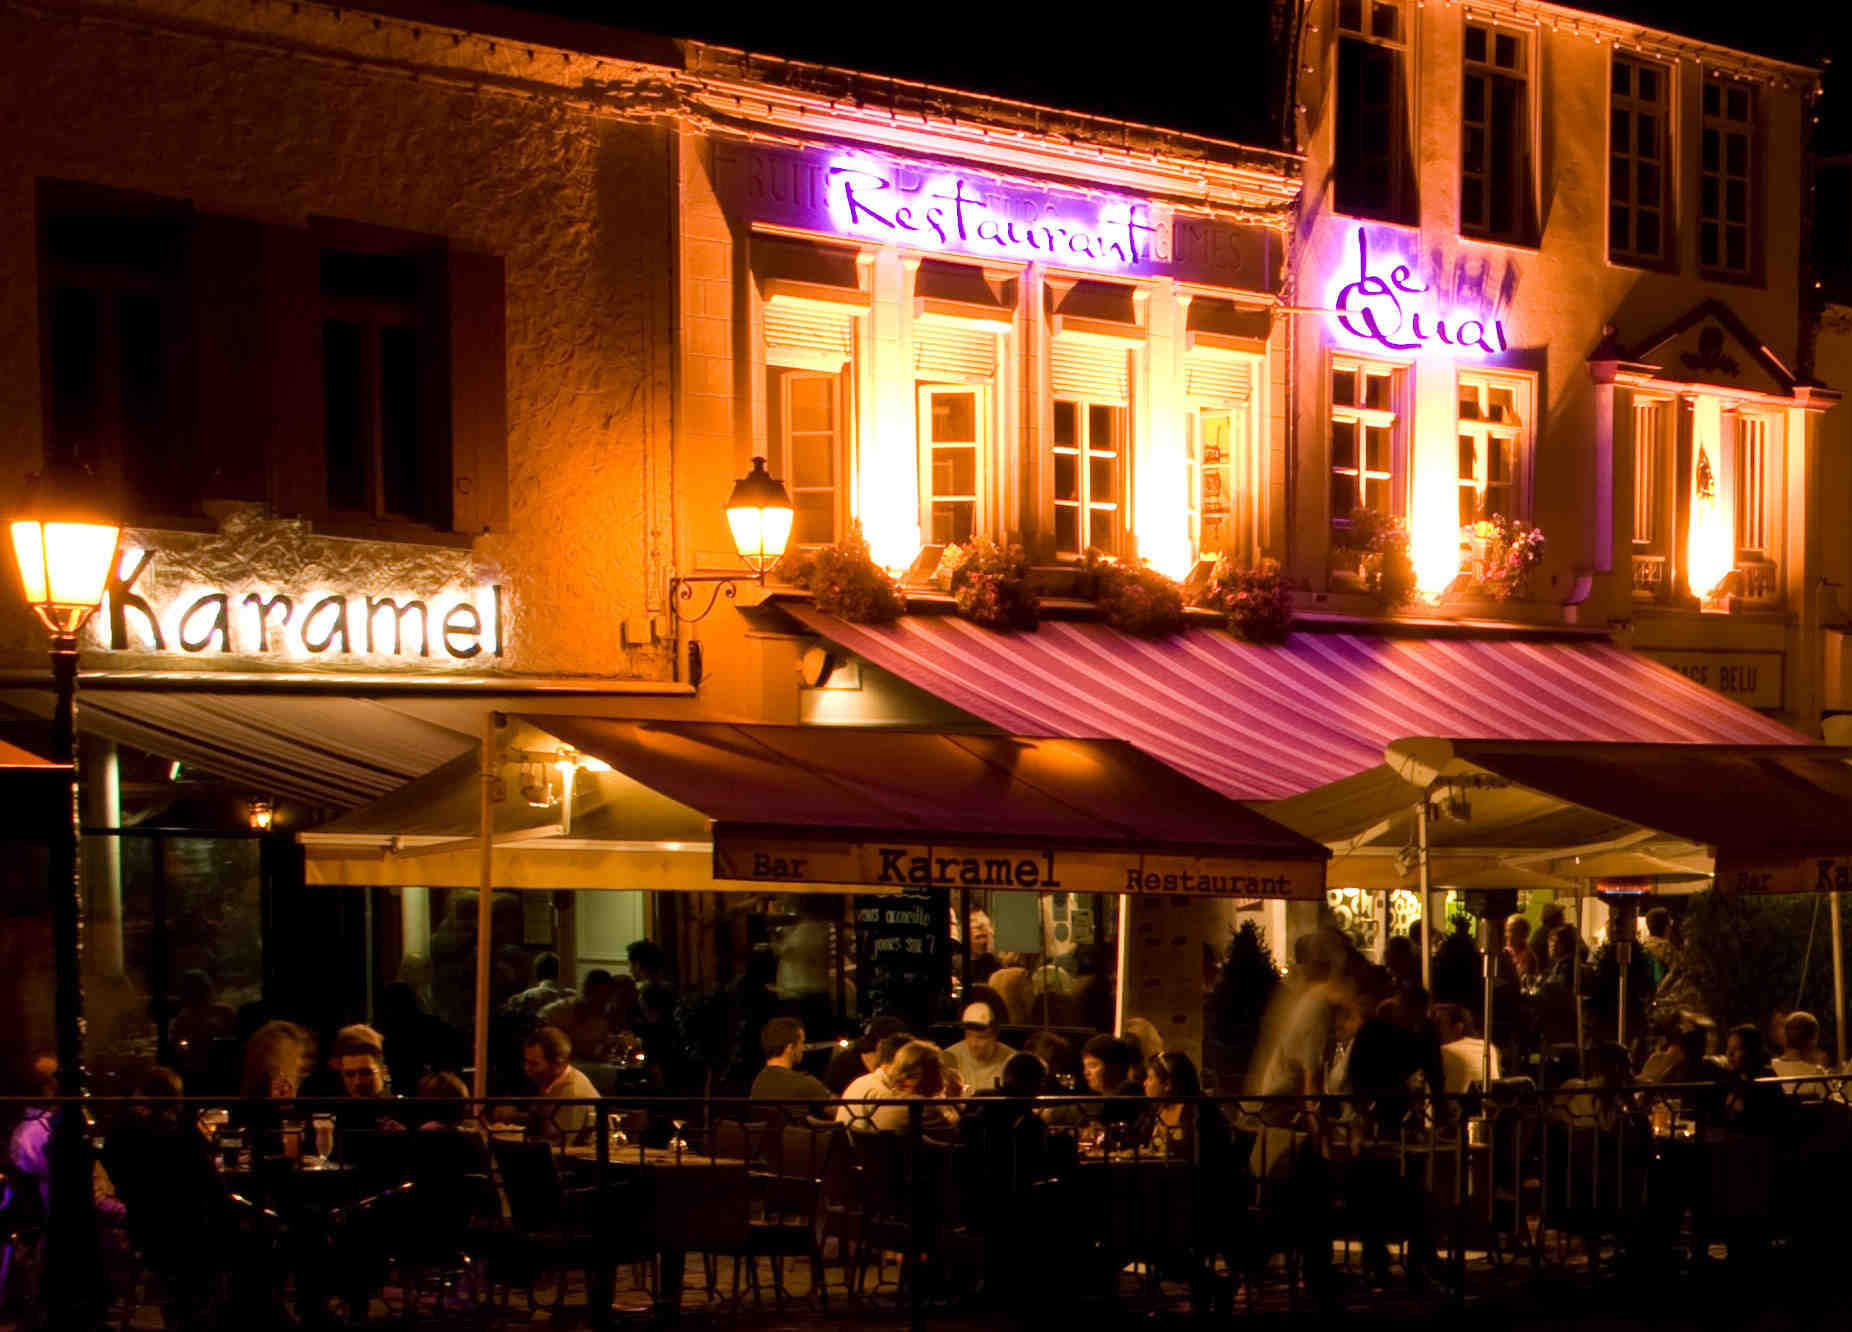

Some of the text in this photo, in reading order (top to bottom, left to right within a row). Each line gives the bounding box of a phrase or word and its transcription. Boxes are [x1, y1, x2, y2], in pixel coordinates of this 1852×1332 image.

[830, 165, 1157, 265] Restaurant
[1357, 226, 1429, 296] Le
[1335, 274, 1508, 353] Quai
[107, 549, 503, 660] Karamel
[752, 848, 1293, 897] Bar Karamel Restaurant
